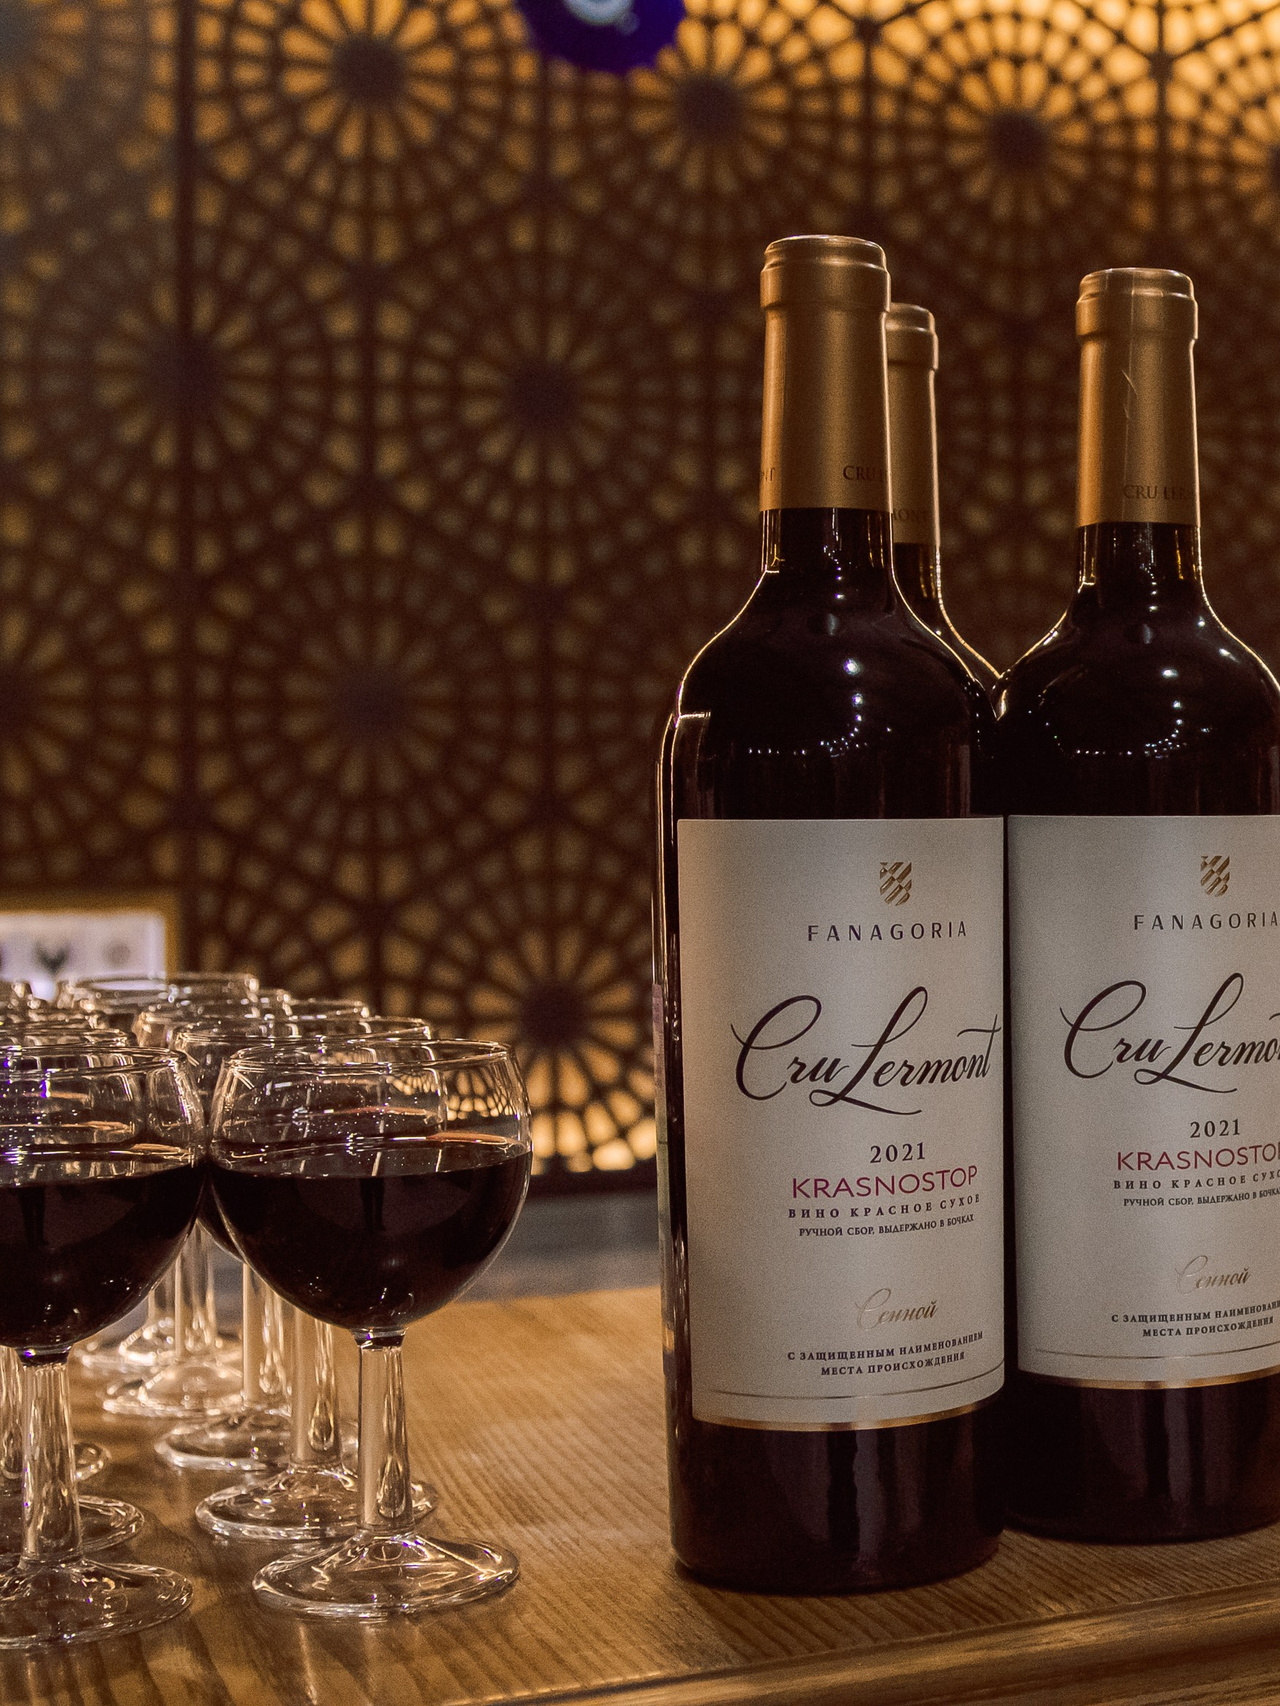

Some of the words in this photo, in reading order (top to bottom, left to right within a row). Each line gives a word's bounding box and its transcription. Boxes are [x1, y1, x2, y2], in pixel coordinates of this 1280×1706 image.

[807, 920, 967, 941] FANAGORIA
[1134, 911, 1278, 930] FANAGORIA
[1060, 980, 1172, 1078] Cru
[730, 995, 849, 1100] Cru
[809, 986, 1002, 1115] Lermont
[1190, 1118, 1241, 1139] 2021
[870, 1141, 926, 1164] 2021
[793, 1165, 978, 1198] KRASNOSTOP
[1113, 1180, 1162, 1190] ВИНО
[1172, 1175, 1246, 1189] КРАСНОЕ
[788, 1208, 839, 1218] ВИНО
[850, 1202, 933, 1218] КРАСНОЕ
[940, 1193, 980, 1210] СУХОЕ
[1123, 1197, 1164, 1207] РУЧНОЙ
[1197, 1192, 1250, 1205] ВЫДЕРЖАНО
[1252, 1191, 1257, 1199] В
[800, 1226, 843, 1236] РУЧНОЙ
[879, 1221, 936, 1234] ВЫДЕРЖАНО
[940, 1219, 945, 1228] В
[947, 1213, 975, 1227] БОЧКАХ
[1112, 1314, 1119, 1322] С
[1123, 1311, 1211, 1324] ЗАЩИЩЕННЫМ
[1143, 1328, 1182, 1337] МЕСТА
[1186, 1315, 1274, 1336] ПРОИСХОЖДЕНИЯ
[788, 1352, 795, 1361] С
[800, 1348, 895, 1362] ЗАЩИЩЕННЫМ
[900, 1330, 983, 1356] НАИМЕНОВАНИЕМ
[821, 1366, 863, 1376] МЕСТА
[868, 1351, 965, 1374] ПРОИСХОЖДЕНИЯ
